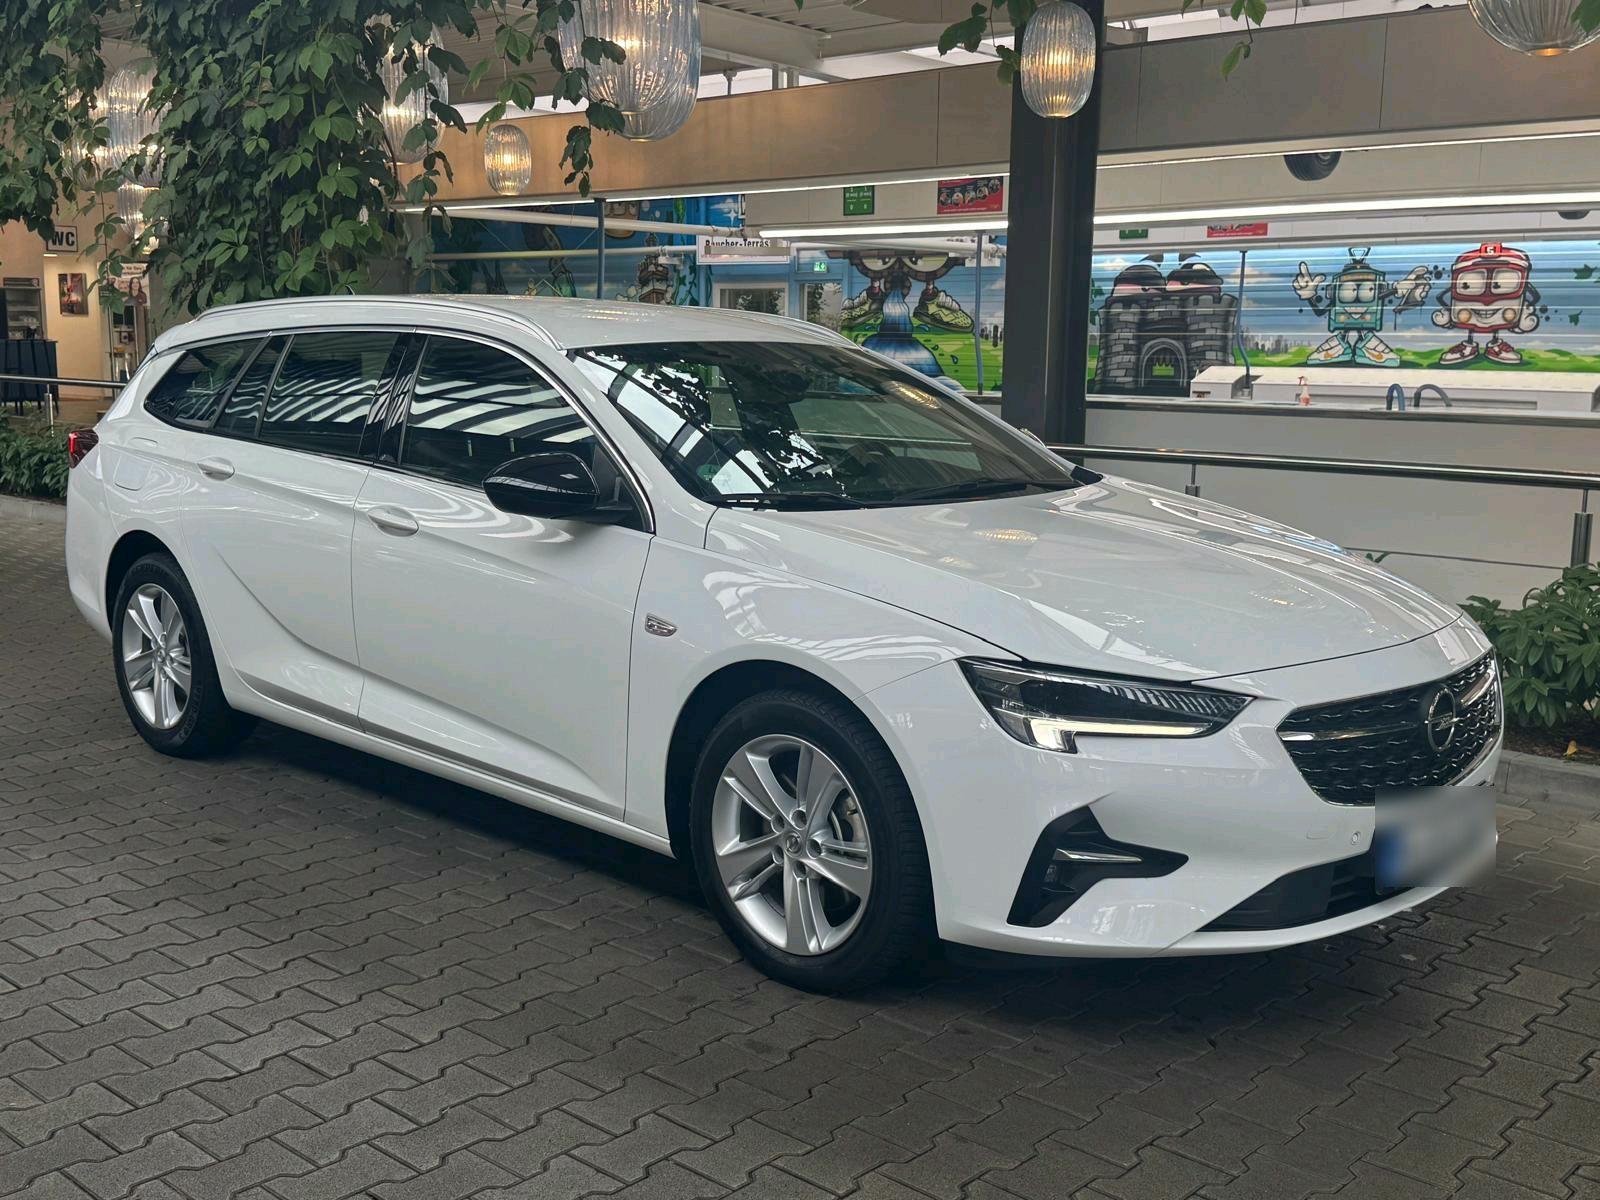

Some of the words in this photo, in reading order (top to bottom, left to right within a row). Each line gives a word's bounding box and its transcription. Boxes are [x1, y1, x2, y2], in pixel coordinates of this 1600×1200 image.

[52, 232, 75, 246] WC
[705, 239, 769, 248] Raucher-Terras
[1487, 247, 1495, 255] 5
